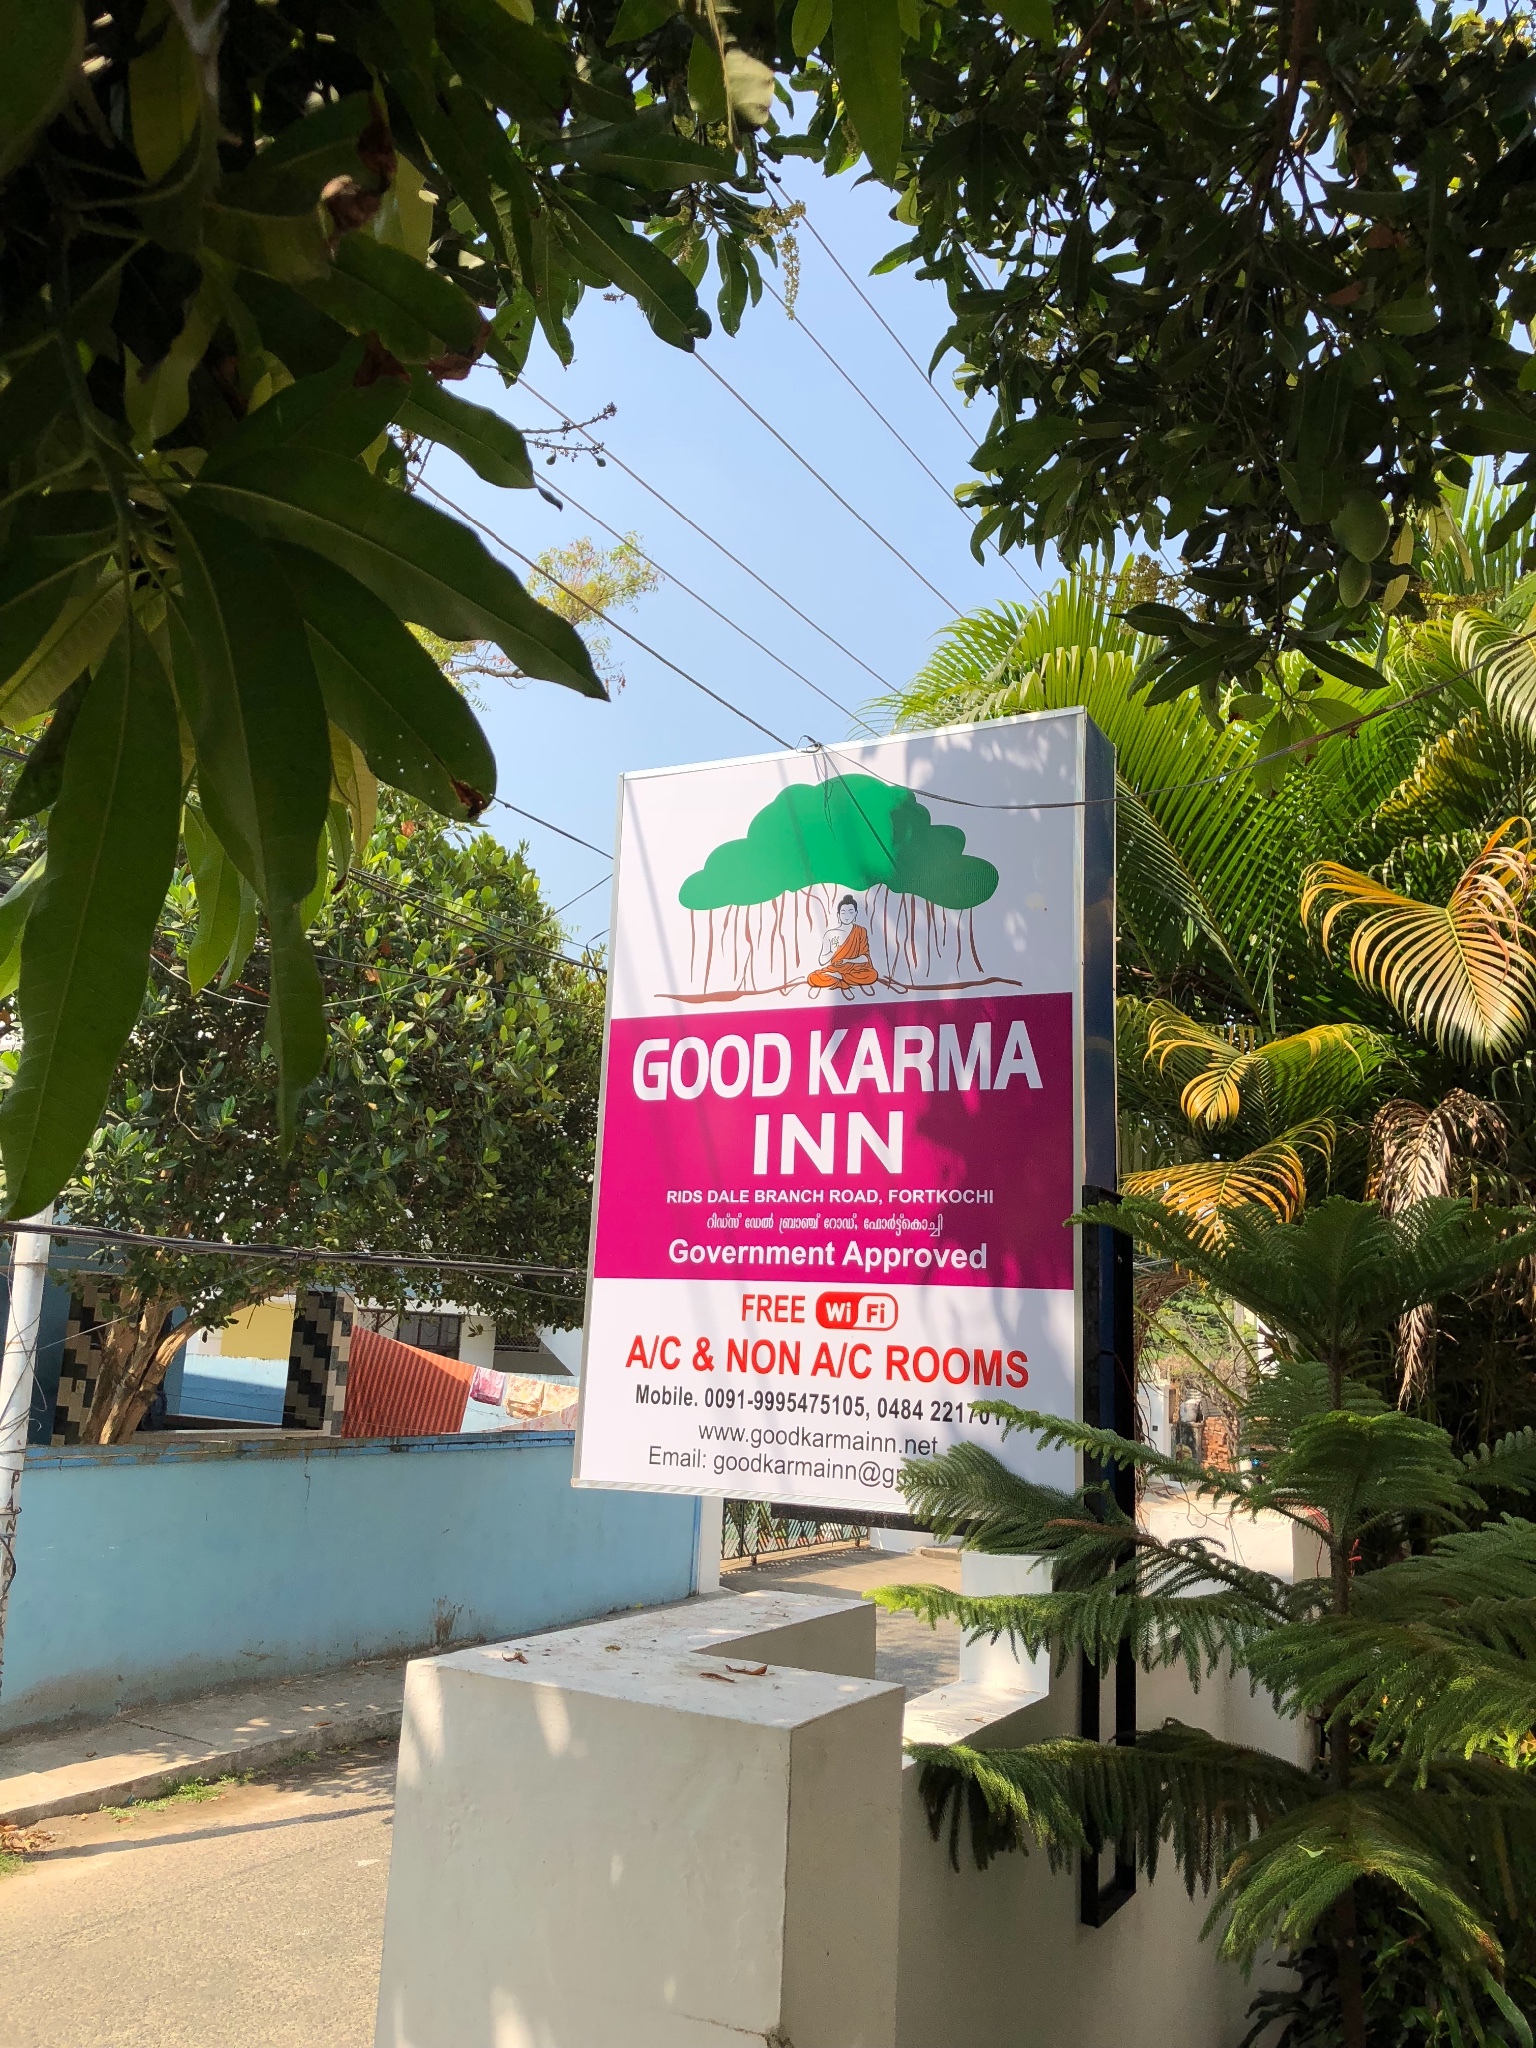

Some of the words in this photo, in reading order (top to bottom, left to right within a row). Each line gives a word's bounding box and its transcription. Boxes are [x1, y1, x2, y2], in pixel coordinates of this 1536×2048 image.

[632, 1032, 792, 1101] GOOD
[808, 1020, 1044, 1096] KARMA
[753, 1110, 904, 1175] INN
[666, 1190, 703, 1204] RIDS
[707, 1189, 750, 1203] DALE
[754, 1189, 825, 1203] BRANCH
[828, 1189, 883, 1205] ROAD,
[888, 1189, 994, 1204] FORTKOCHI
[668, 1238, 835, 1266] Government
[841, 1240, 987, 1273] Approved
[741, 1293, 806, 1323] FREE
[625, 1334, 682, 1371] A/C
[692, 1336, 715, 1372] &
[726, 1337, 801, 1376] NON
[810, 1341, 873, 1380] A/C
[885, 1344, 1029, 1389] ROOMS
[635, 1383, 698, 1407] Mobile.
[704, 1387, 870, 1421] 0091-9995475105,
[877, 1397, 924, 1421] 0484
[698, 1424, 938, 1456] www.goodkarmainn.net
[648, 1445, 707, 1470] Email:
[713, 1452, 904, 1489] goodkarmainn@g
